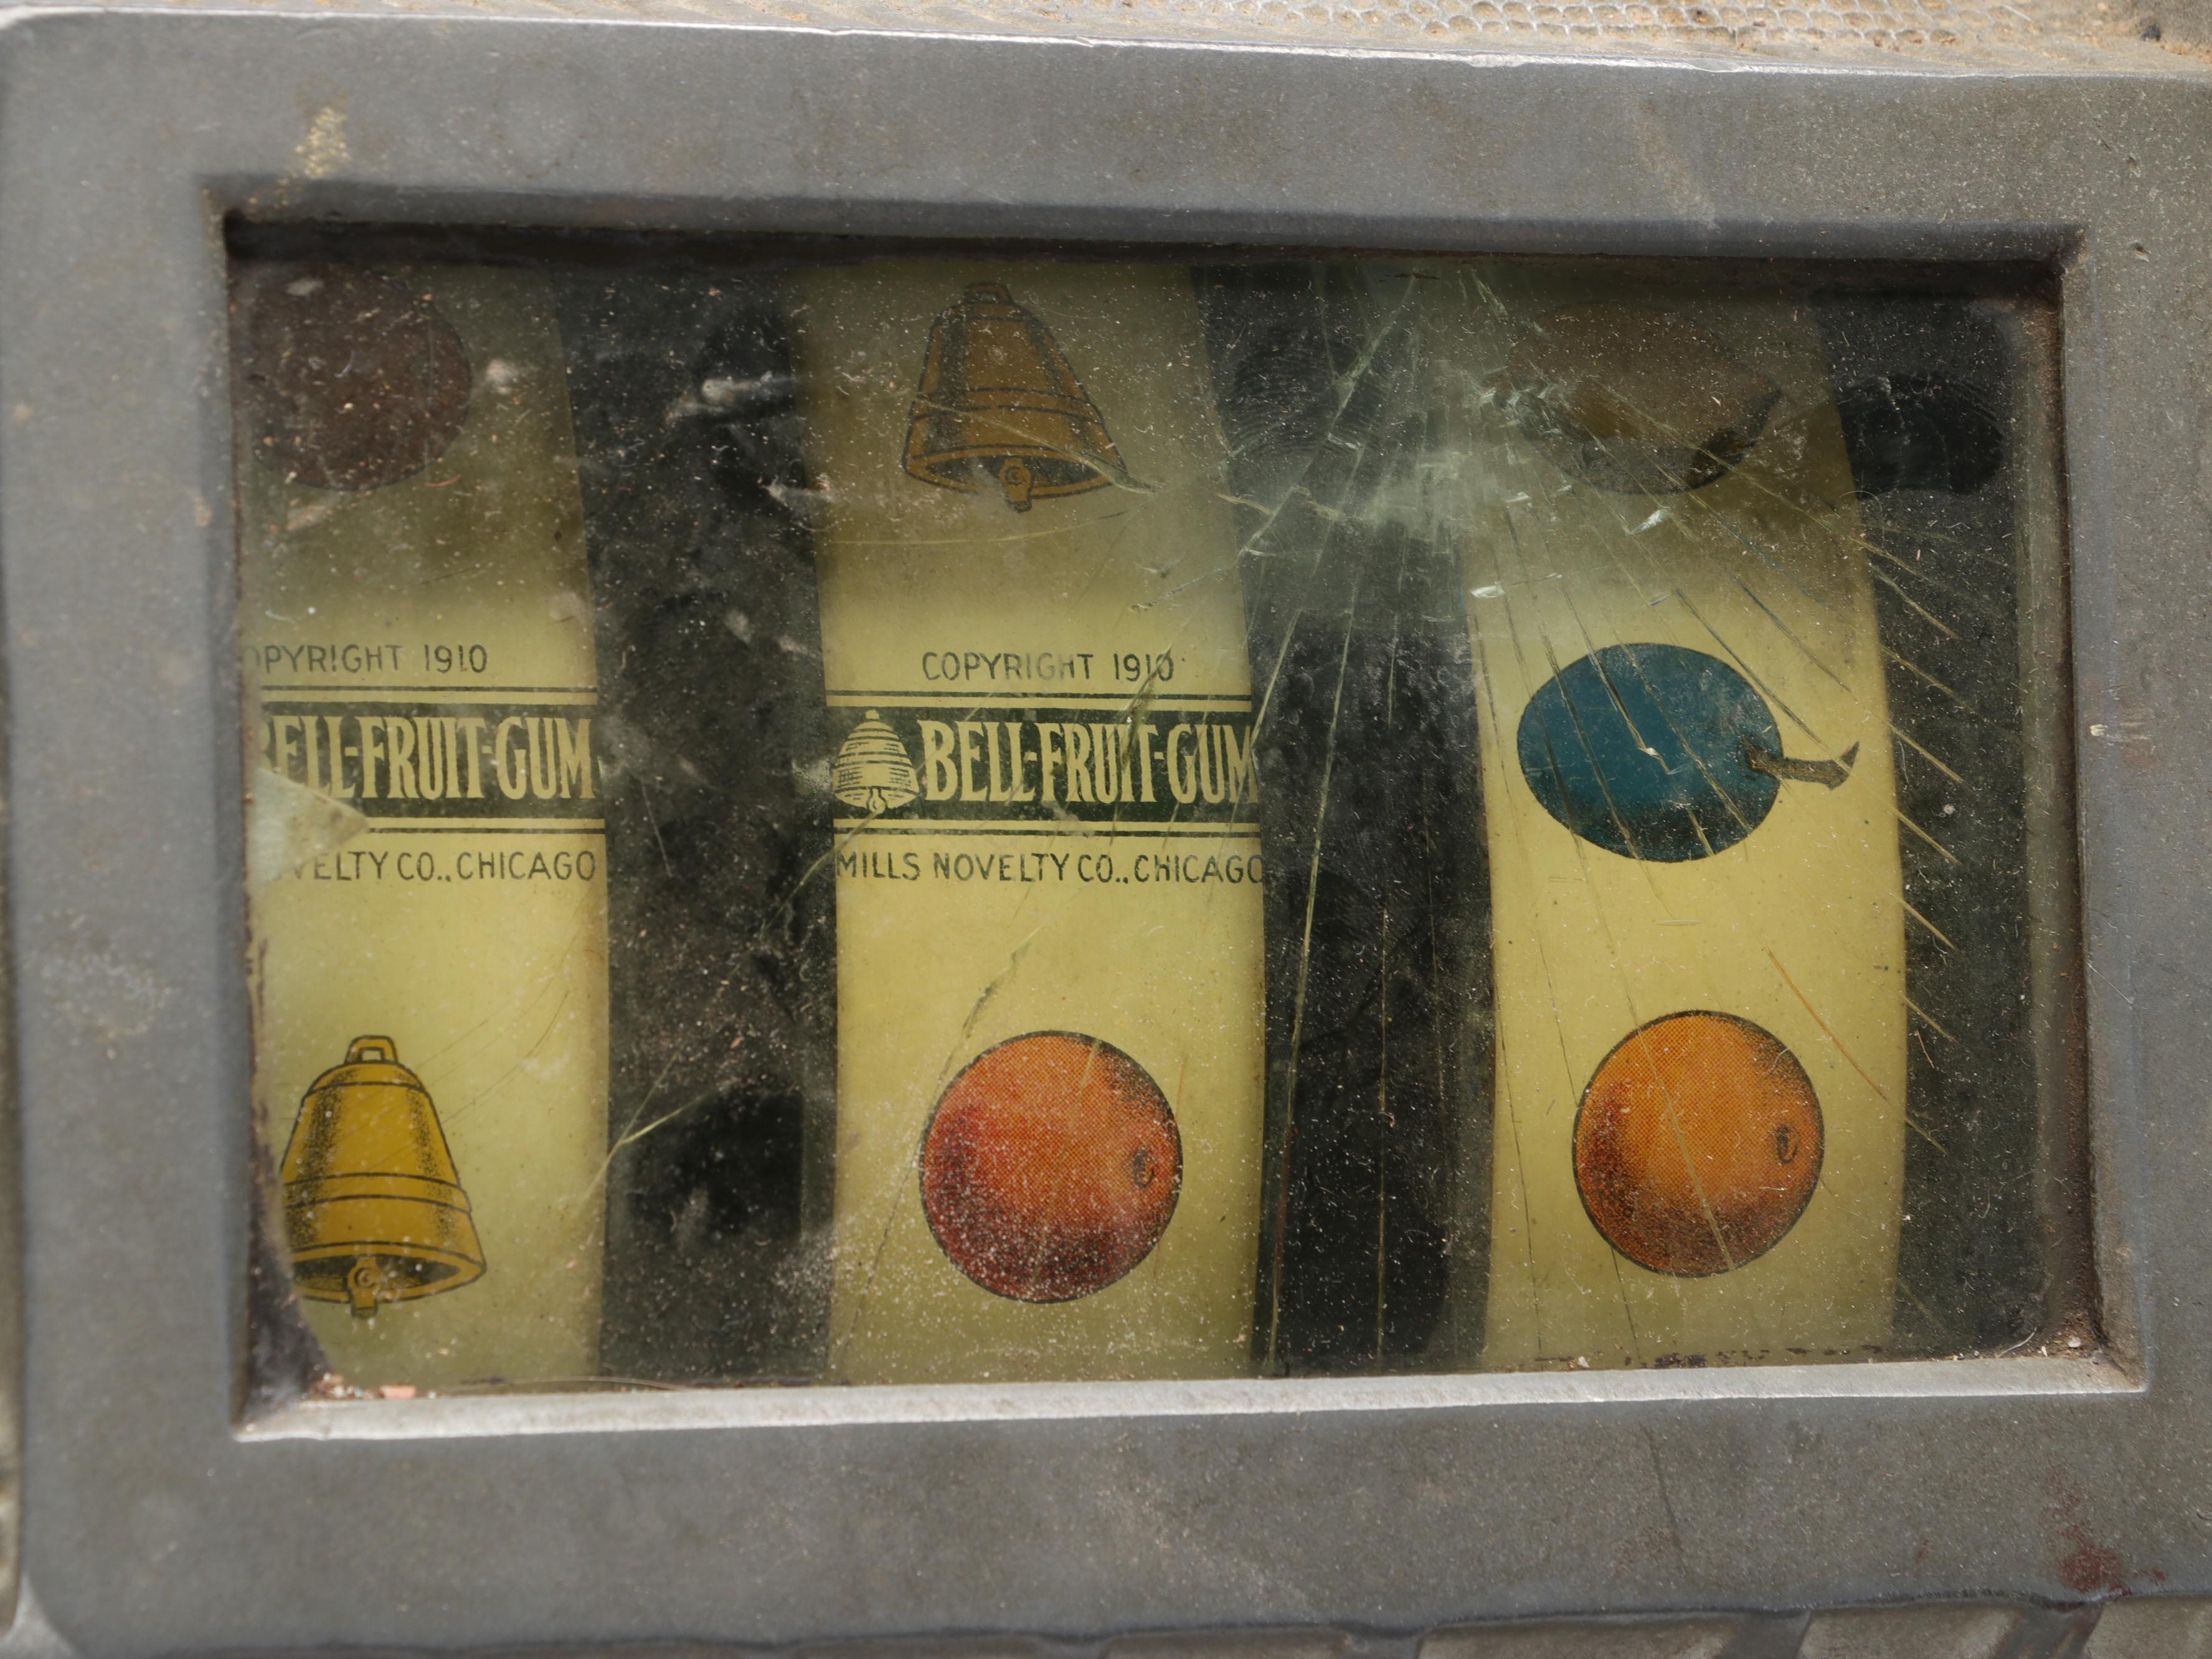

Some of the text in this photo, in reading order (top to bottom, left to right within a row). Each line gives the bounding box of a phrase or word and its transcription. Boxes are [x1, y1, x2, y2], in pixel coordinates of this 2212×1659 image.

[424, 644, 488, 673] 1910
[922, 651, 1175, 681] COPYRIGHT 1910
[917, 719, 1259, 804] BELL-FRUIT-GUM
[456, 851, 596, 881] CHICAGO
[836, 852, 920, 881] MILLS
[933, 853, 1070, 882] NOVELTY
